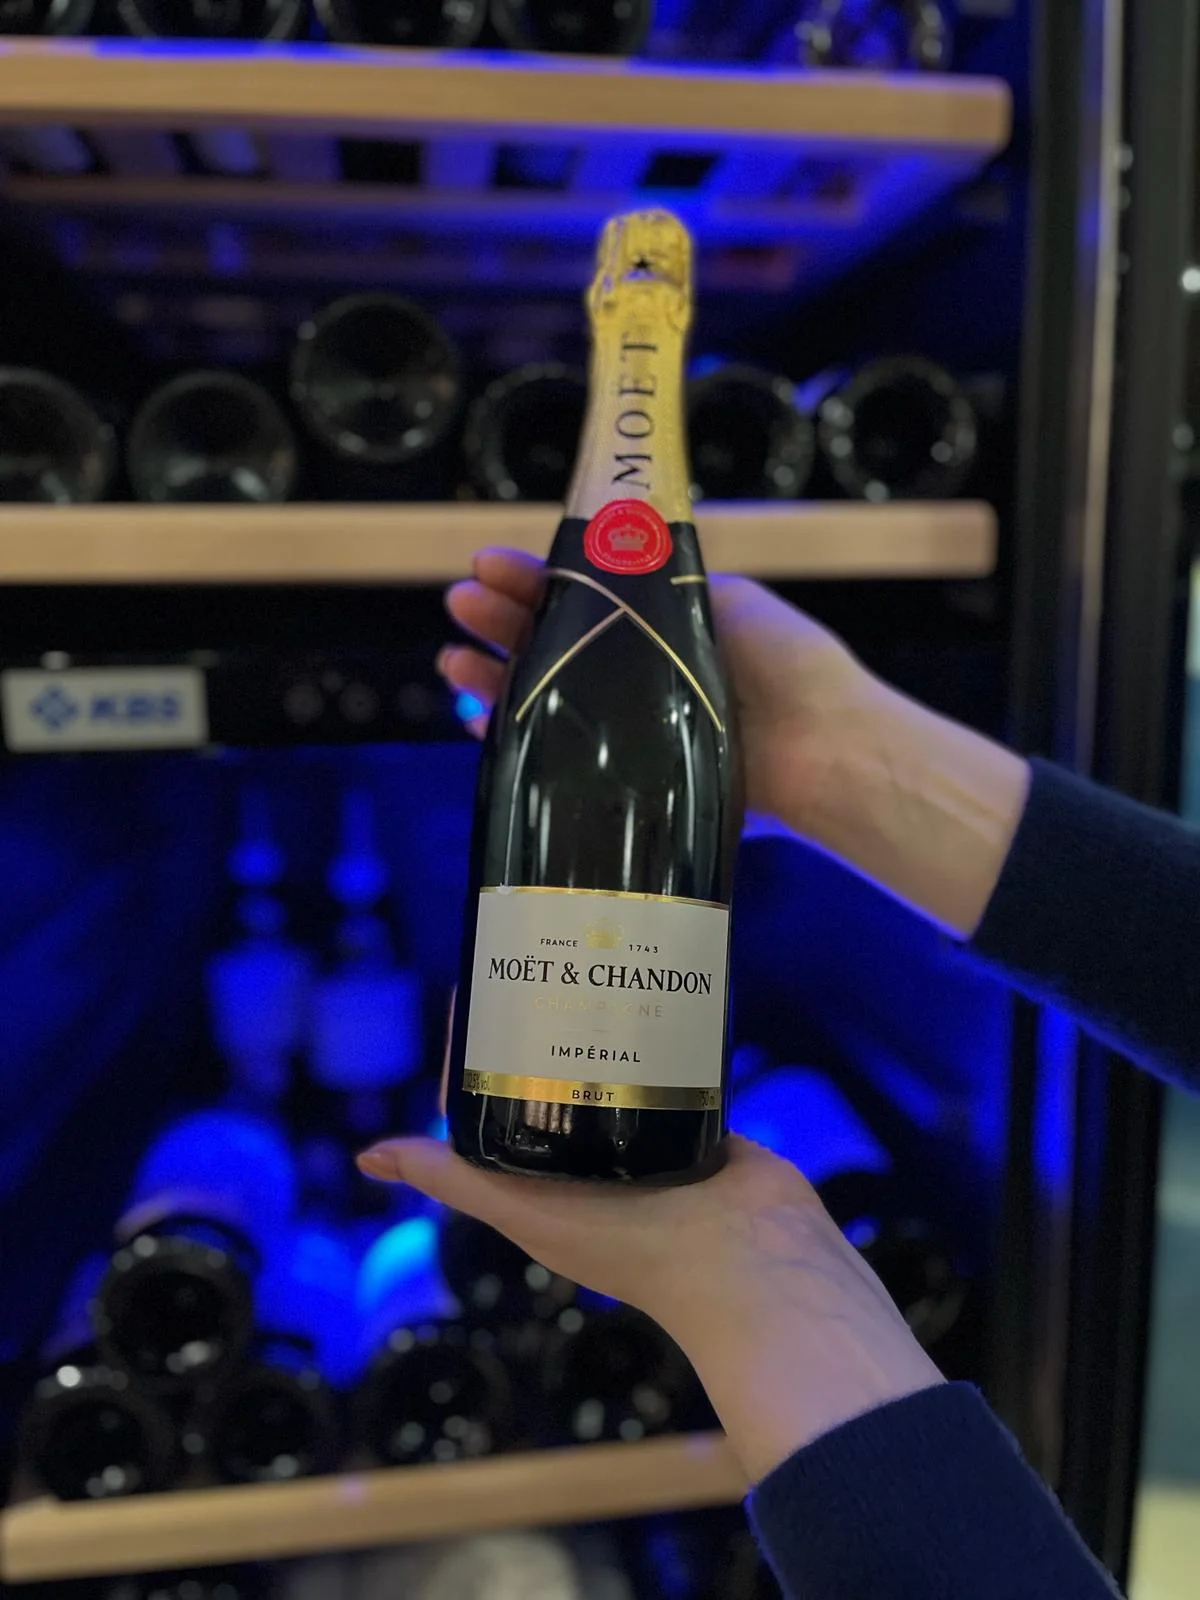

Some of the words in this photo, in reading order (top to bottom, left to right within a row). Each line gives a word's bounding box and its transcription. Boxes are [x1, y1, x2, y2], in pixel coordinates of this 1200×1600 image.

[540, 938, 579, 948] FRANCE
[629, 944, 659, 954] 1743
[488, 954, 555, 983] MOËT
[560, 961, 580, 985] &
[588, 964, 712, 995] CHANDON
[534, 996, 664, 1018] CHAMPGNE
[551, 1045, 641, 1063] IMPÉRIAL
[571, 1088, 615, 1102] BRUT
